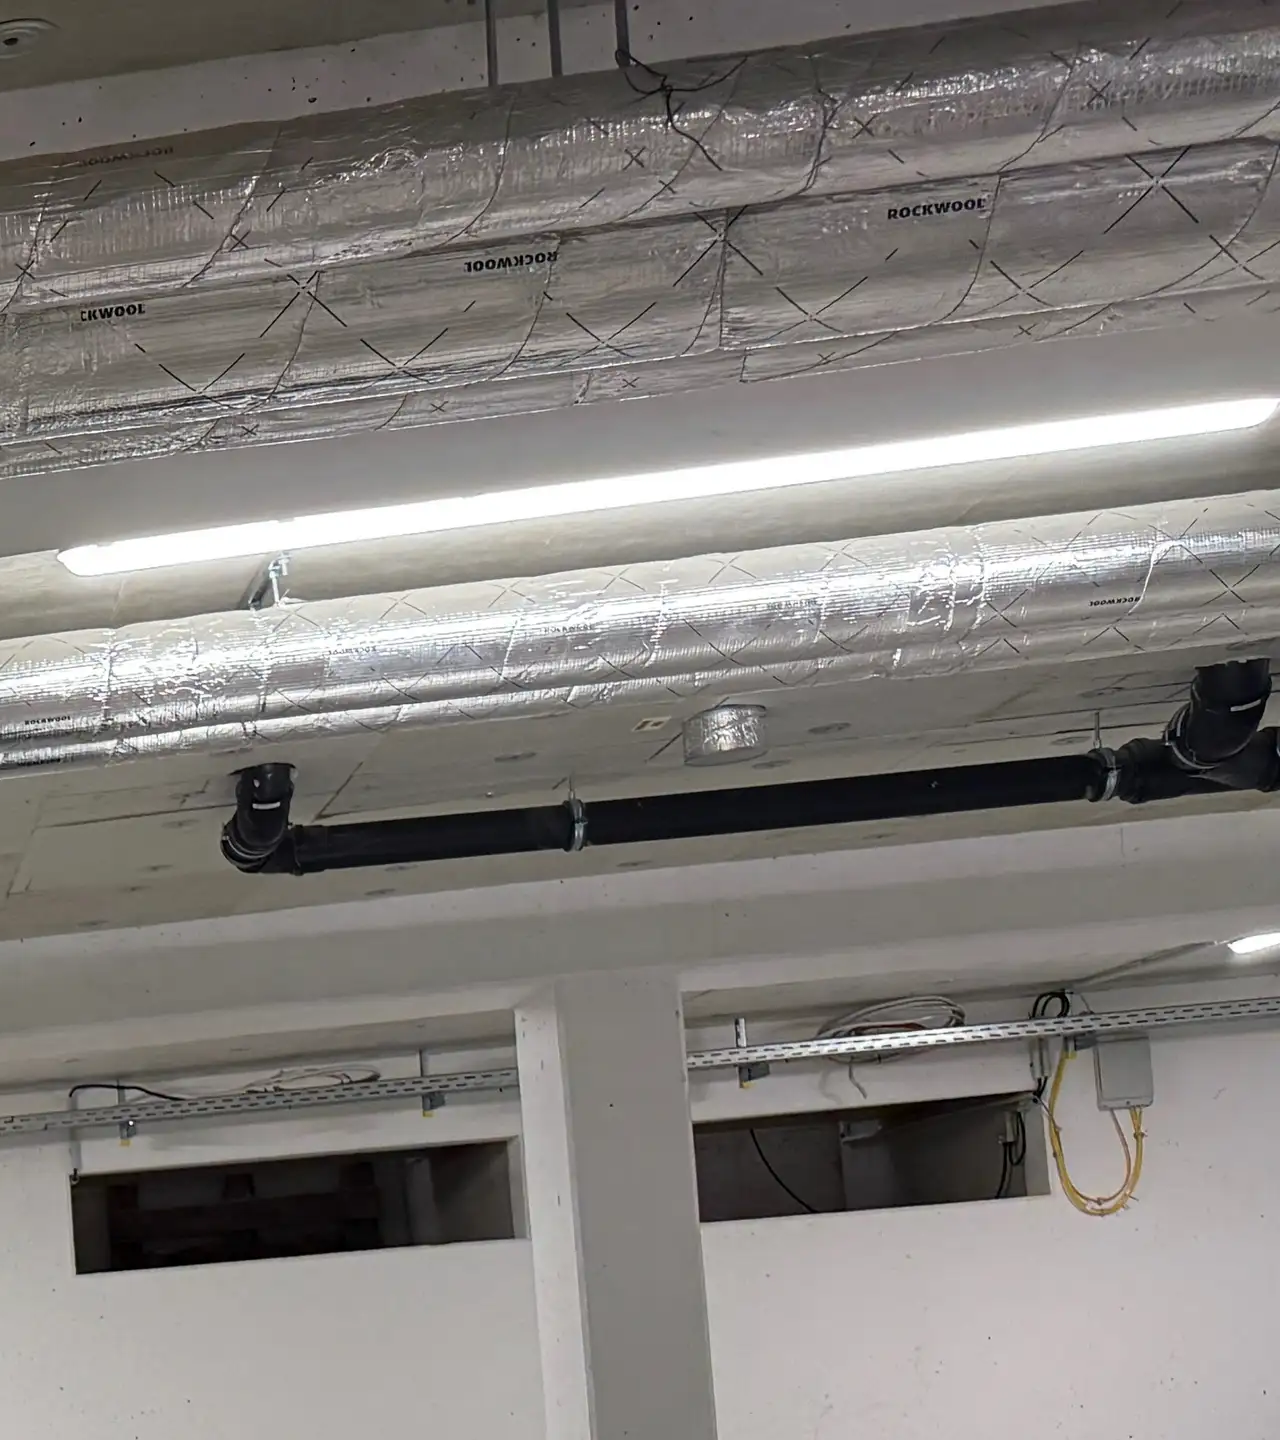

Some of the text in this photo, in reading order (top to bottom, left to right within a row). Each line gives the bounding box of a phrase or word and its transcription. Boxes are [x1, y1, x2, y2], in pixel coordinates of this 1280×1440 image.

[887, 198, 987, 221] ROCKWOOL
[464, 251, 559, 274] ROCKWOOL
[1089, 595, 1142, 607] ROCKWOOL
